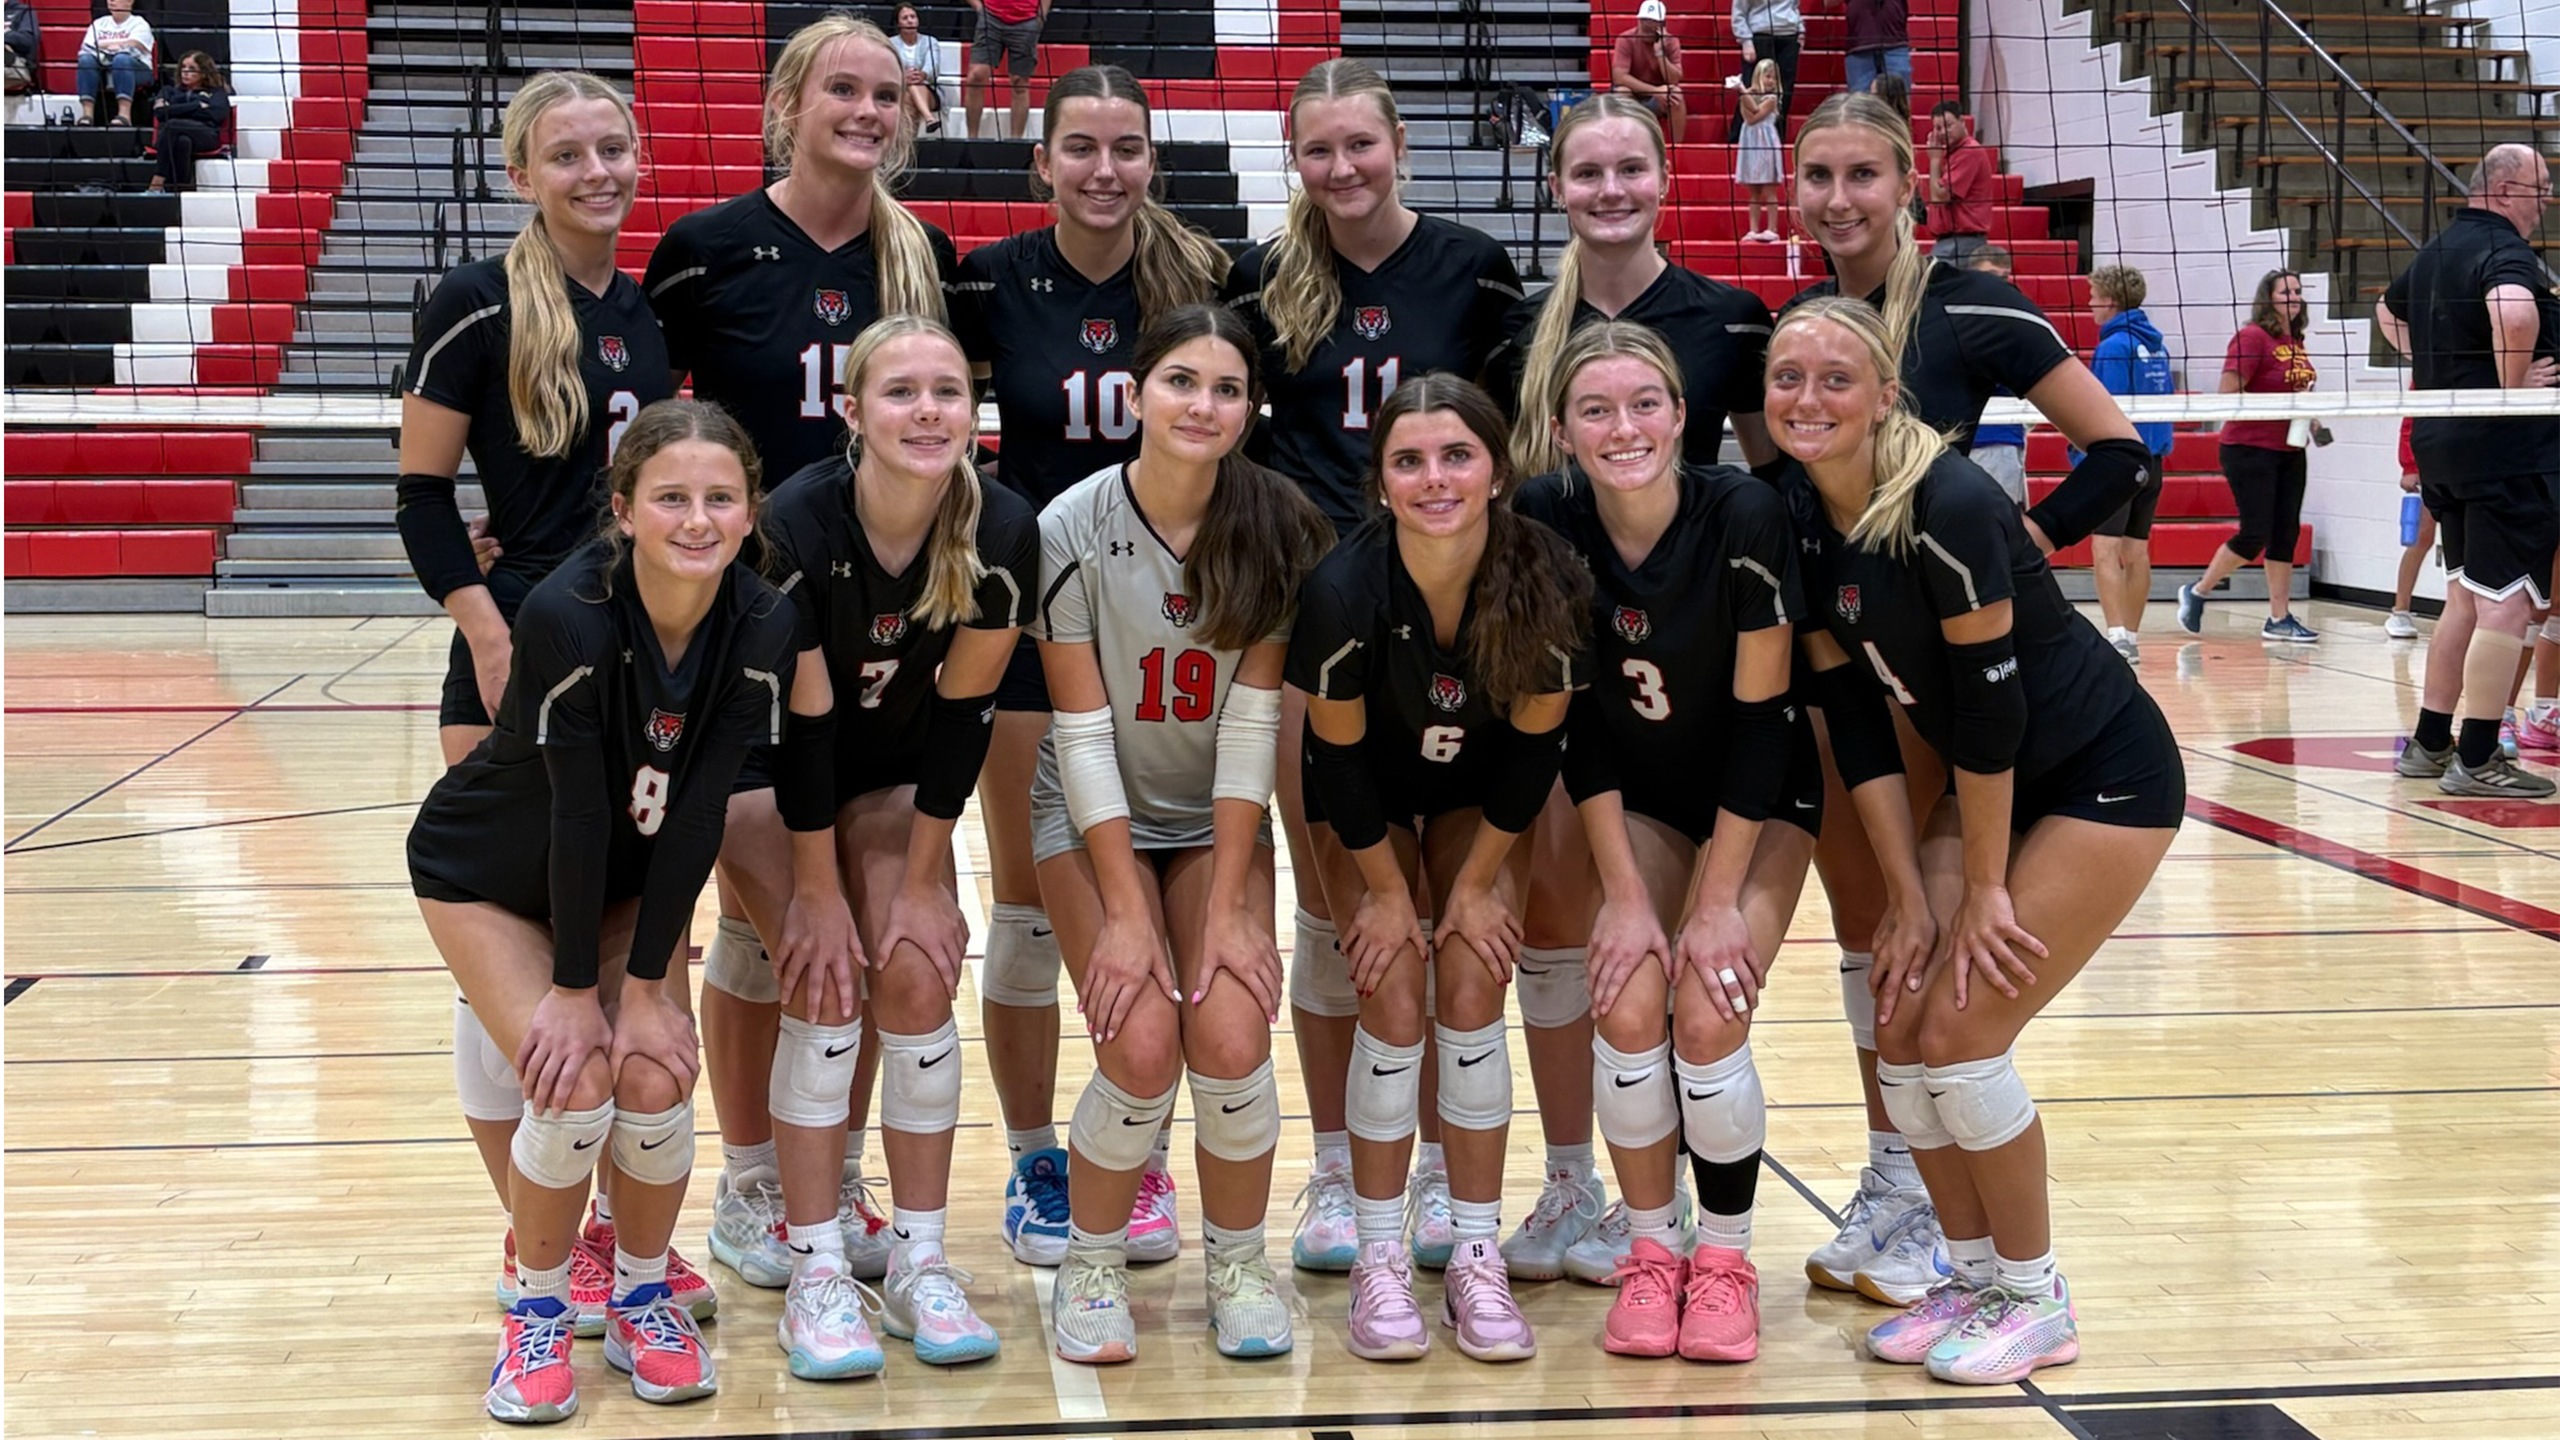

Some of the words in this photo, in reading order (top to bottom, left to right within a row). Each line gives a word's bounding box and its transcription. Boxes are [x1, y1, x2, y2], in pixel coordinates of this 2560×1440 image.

[800, 342, 852, 418] 15
[1062, 369, 1139, 440] 10
[1341, 355, 1401, 430] 11
[606, 390, 641, 467] 2
[858, 659, 900, 709] 7
[1135, 647, 1217, 723] 19
[1621, 658, 1672, 721] 3
[1420, 725, 1465, 763] 6
[628, 764, 671, 836] 8
